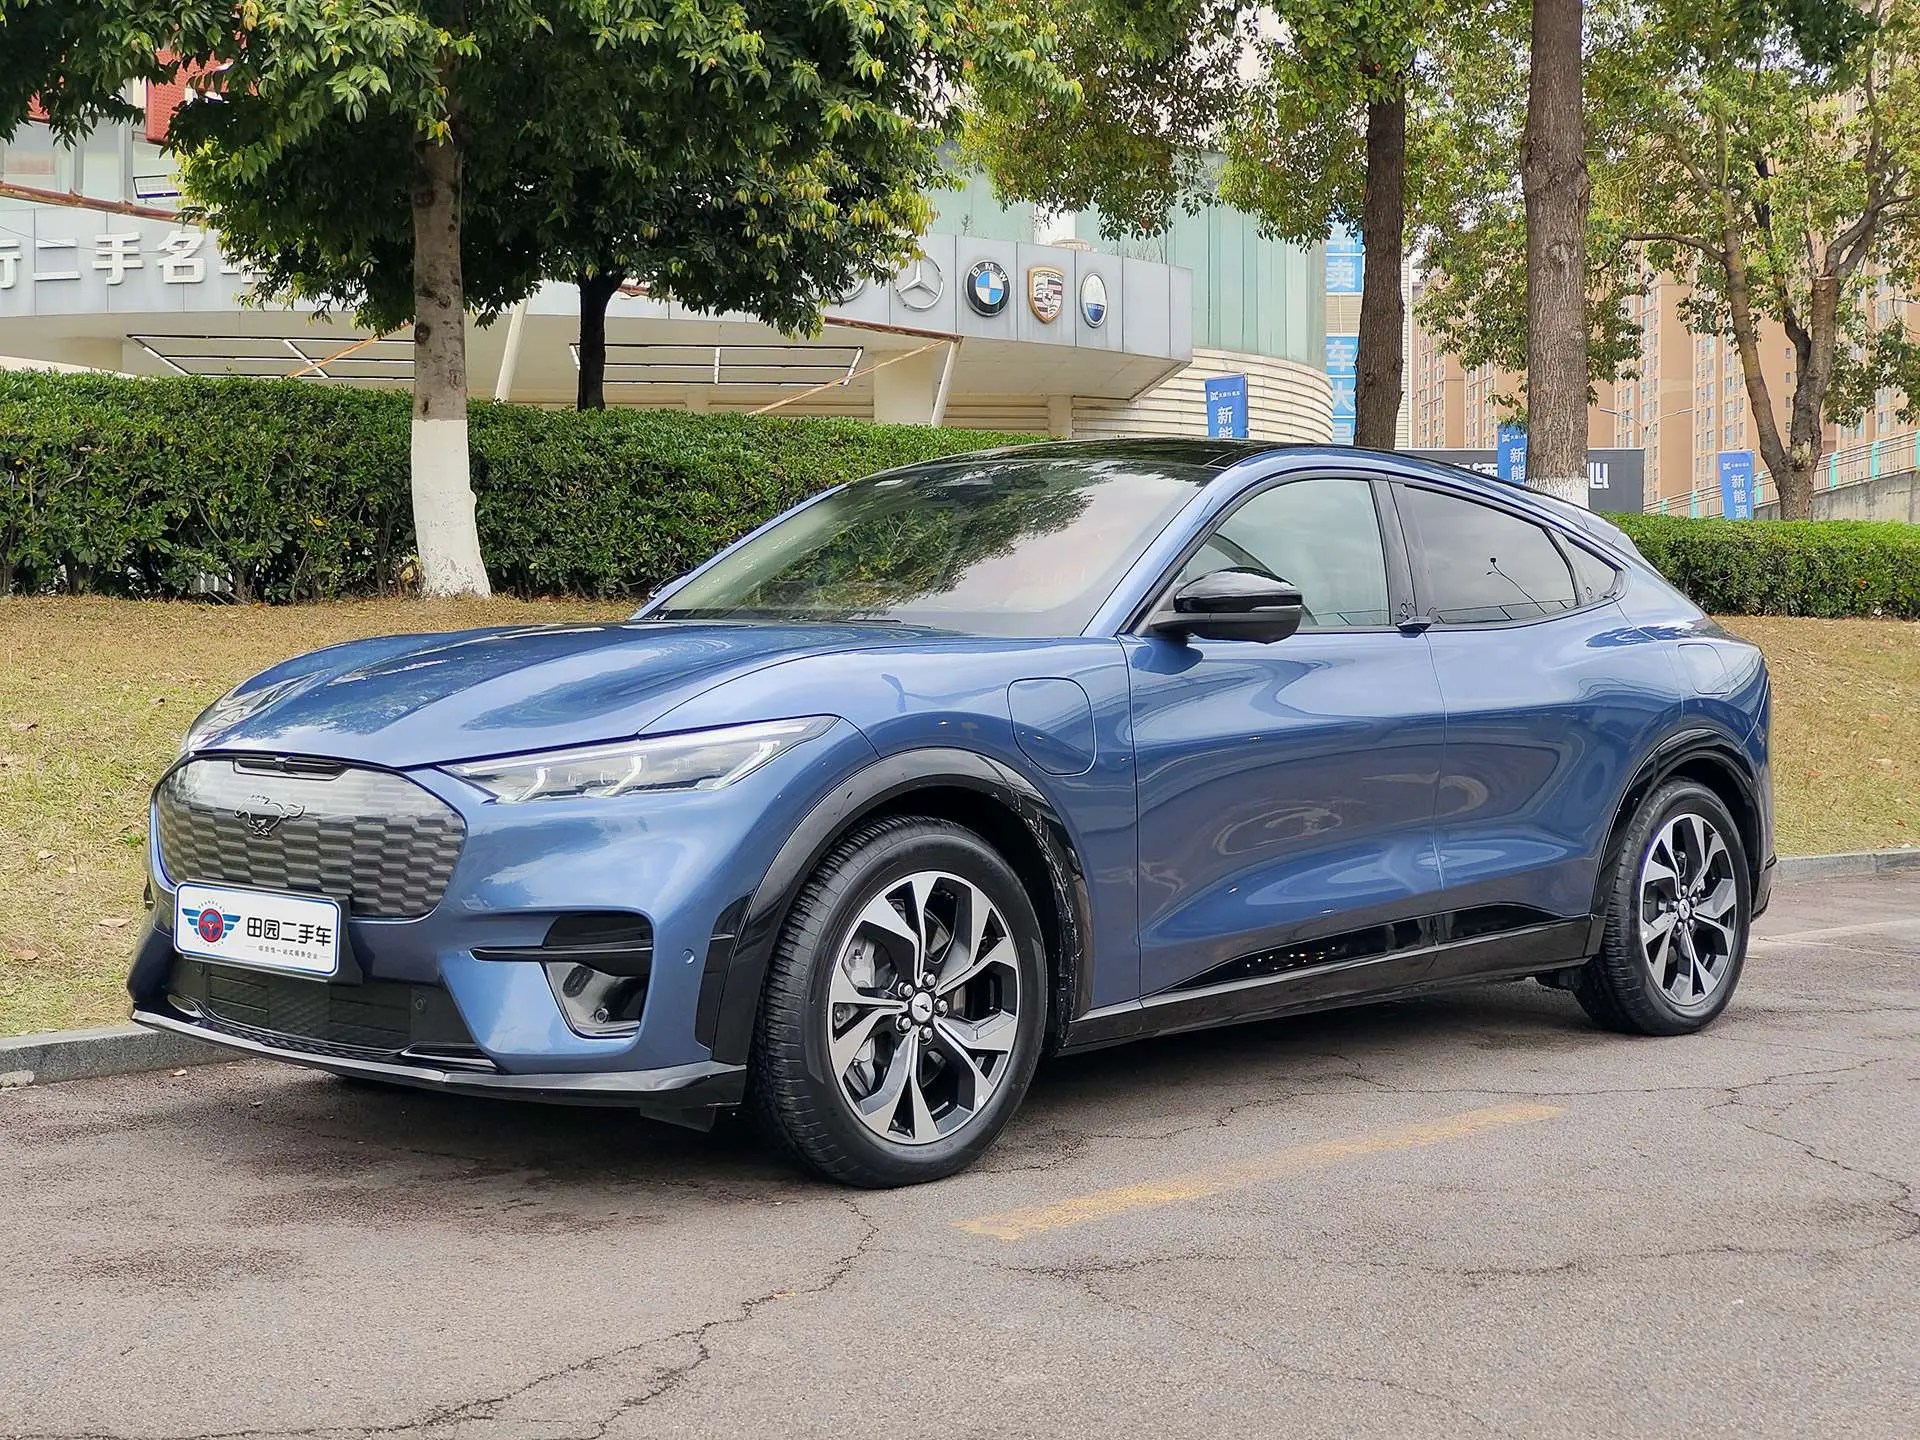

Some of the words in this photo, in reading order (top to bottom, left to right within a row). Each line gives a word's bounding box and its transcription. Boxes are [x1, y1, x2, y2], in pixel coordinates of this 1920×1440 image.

[971, 263, 1008, 282] BMW
[1731, 474, 1748, 518] 新能源
[246, 916, 332, 947] 田园二手车
